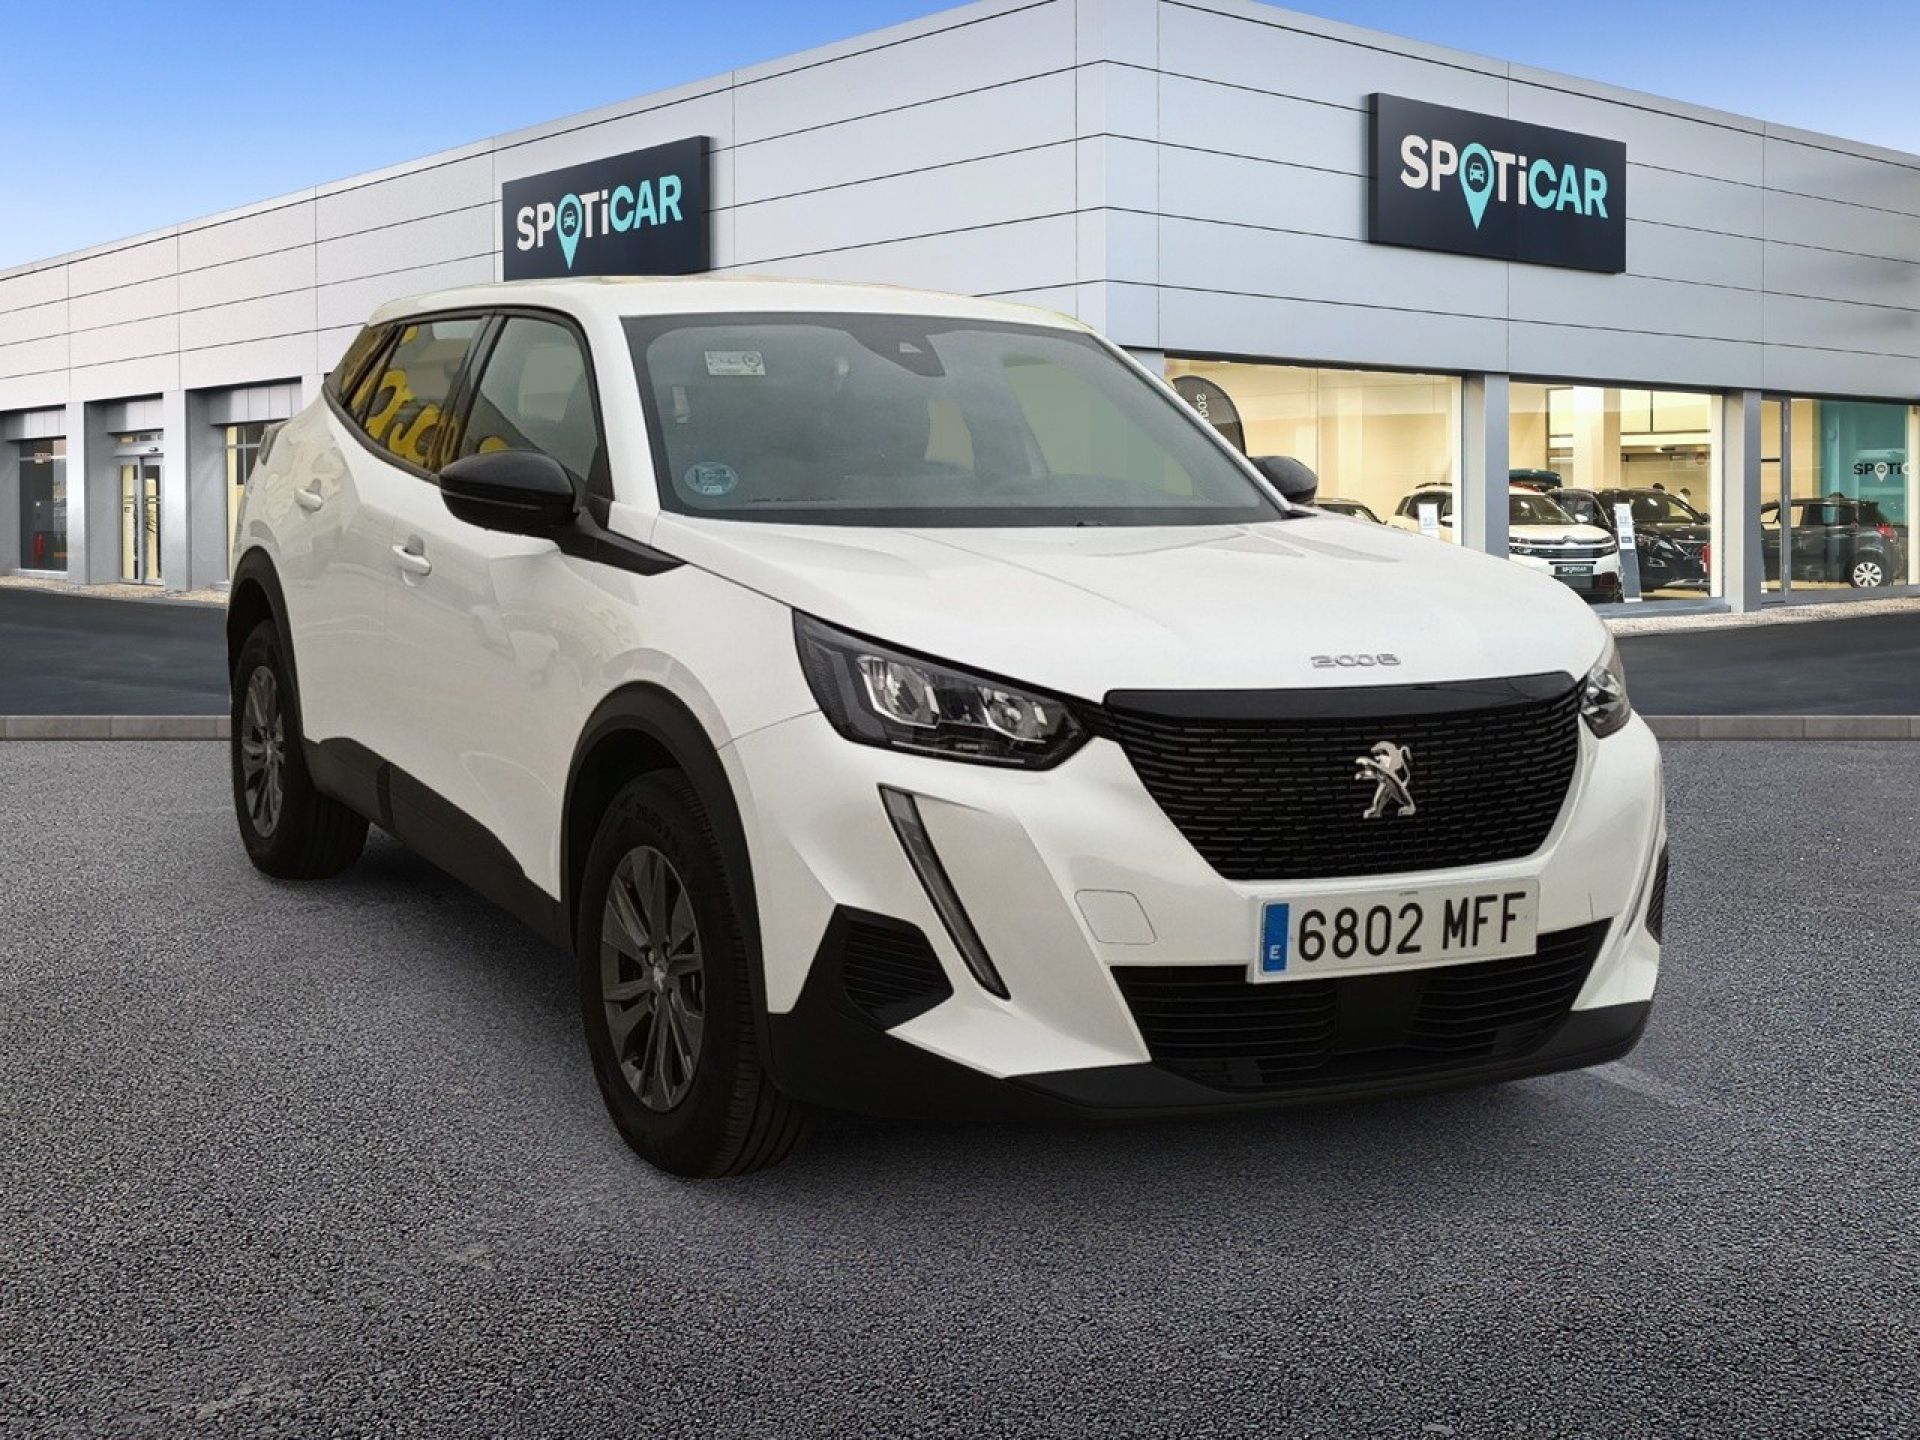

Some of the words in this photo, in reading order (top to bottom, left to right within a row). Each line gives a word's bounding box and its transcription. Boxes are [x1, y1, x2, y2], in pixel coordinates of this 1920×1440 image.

[1268, 944, 1281, 960] E
[1298, 902, 1424, 962] 6802
[1442, 891, 1526, 950] MFF
